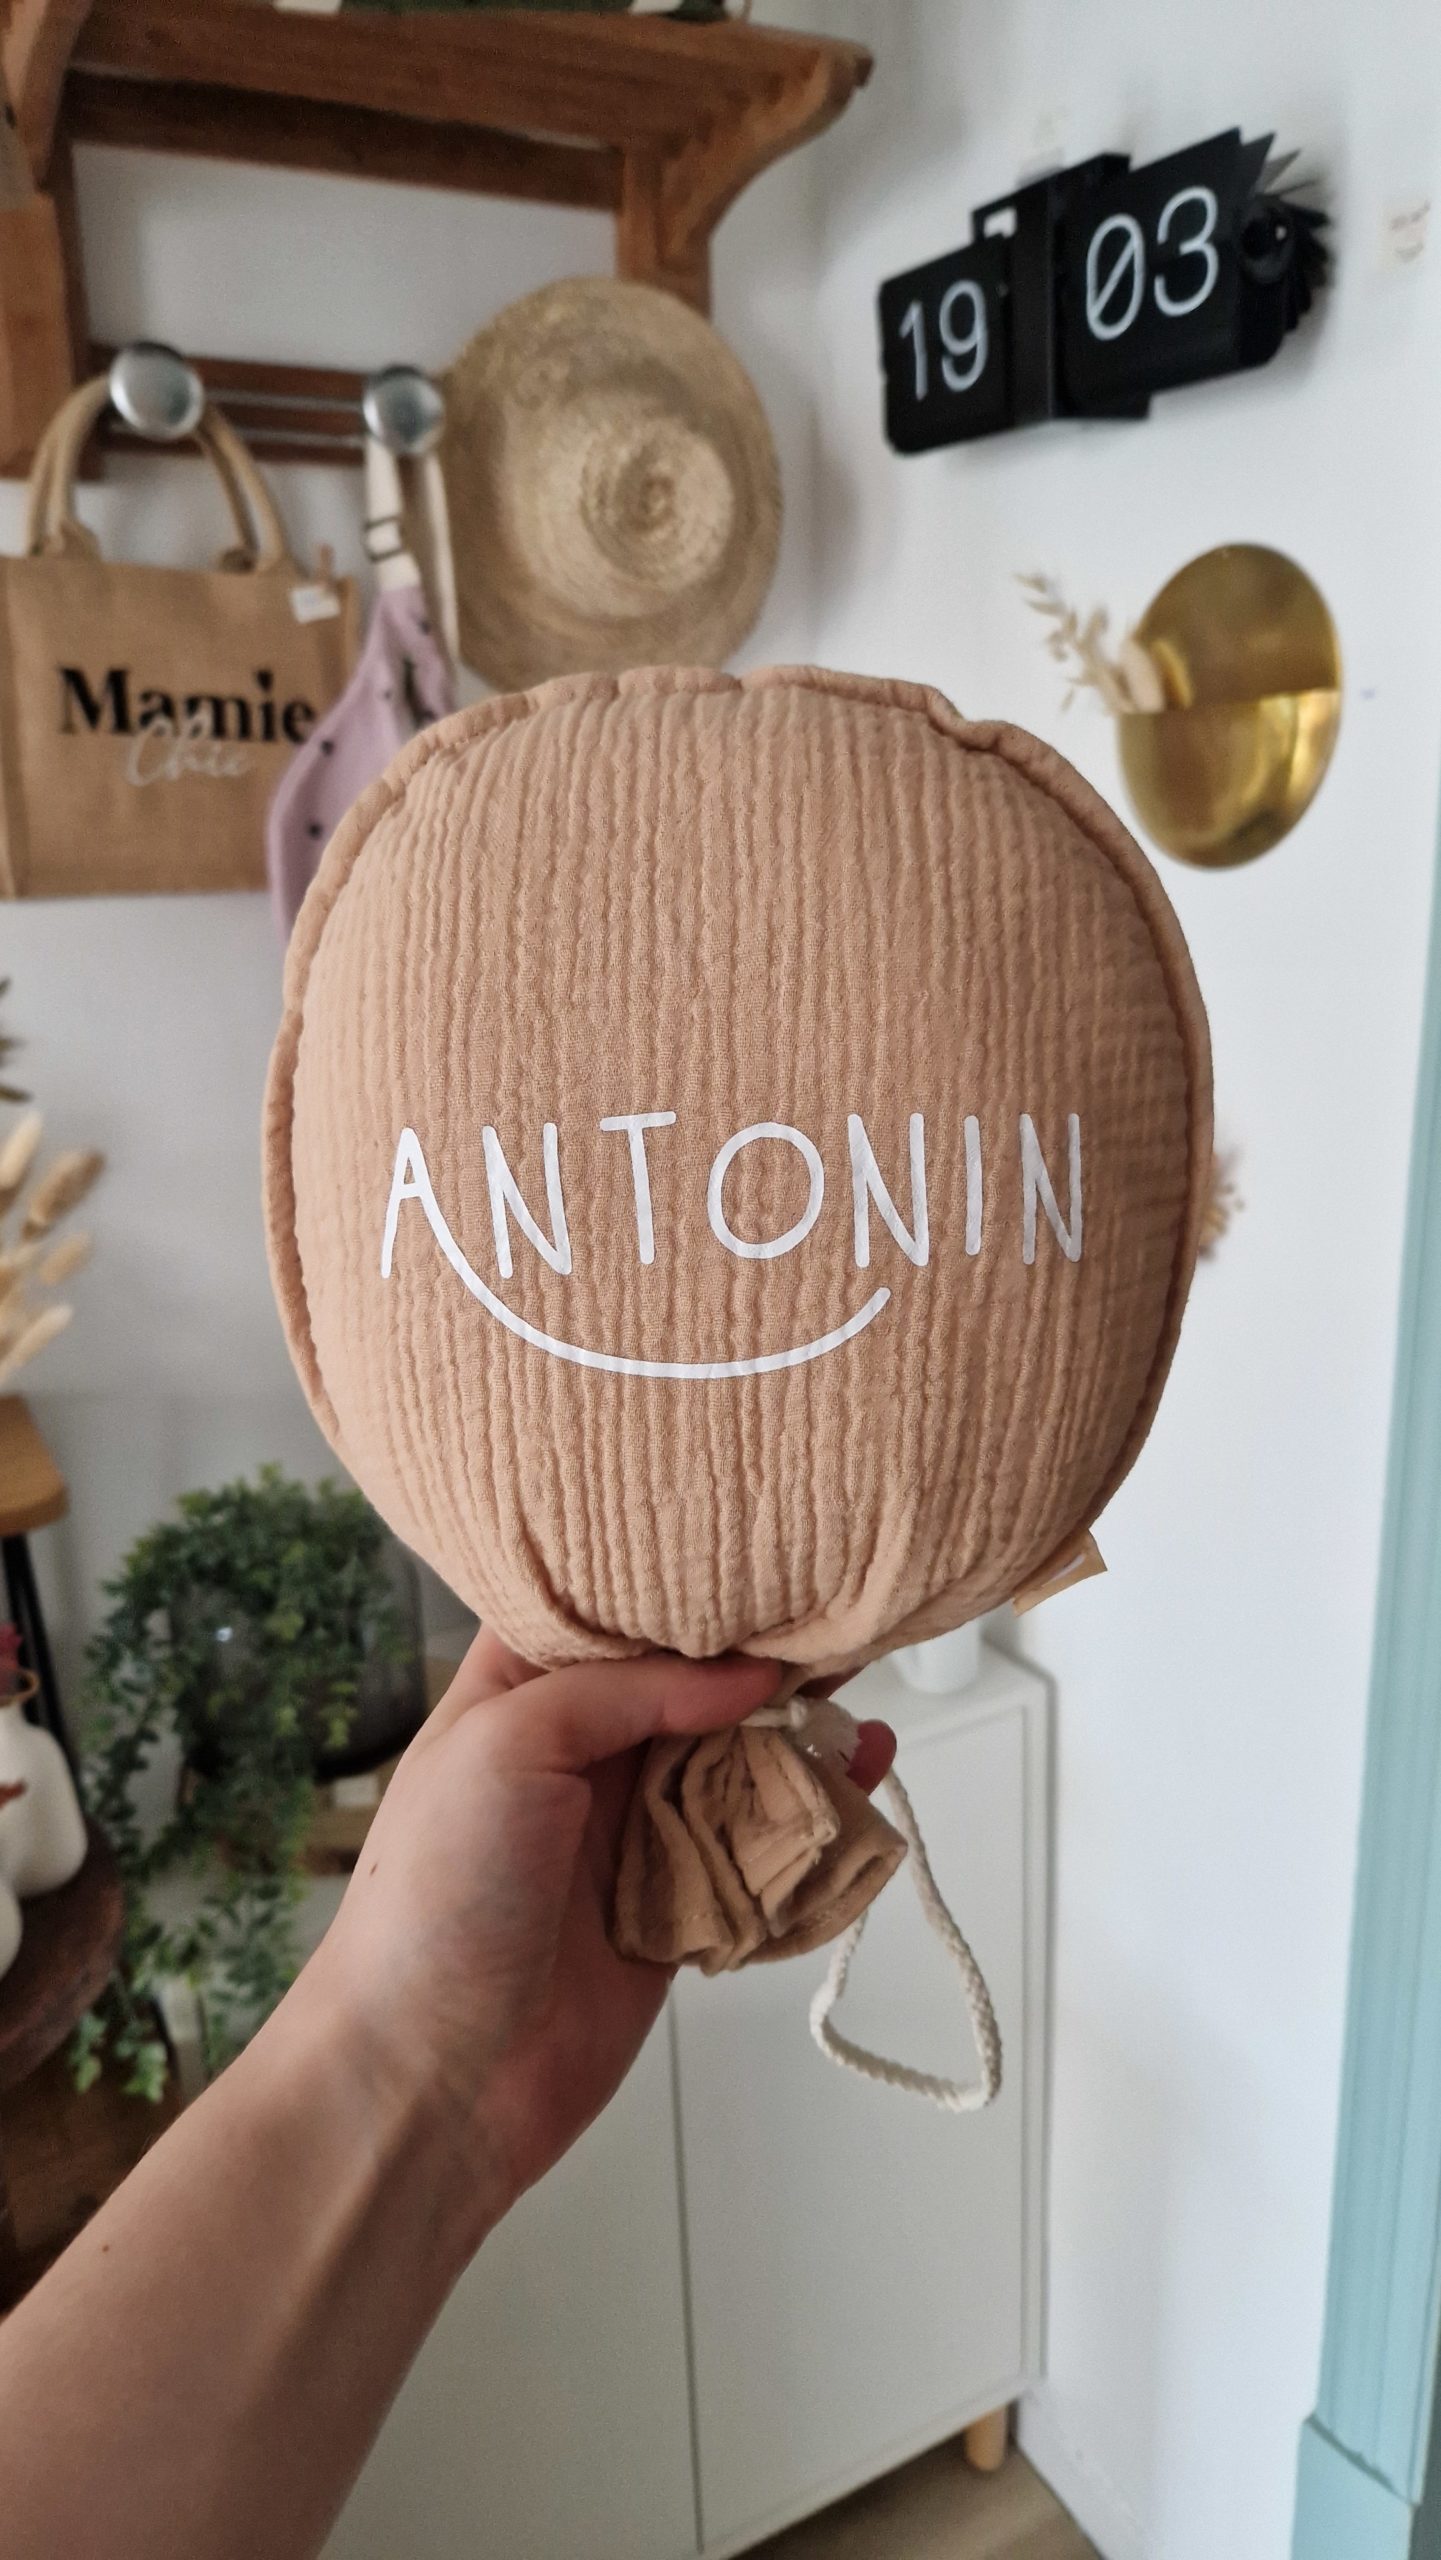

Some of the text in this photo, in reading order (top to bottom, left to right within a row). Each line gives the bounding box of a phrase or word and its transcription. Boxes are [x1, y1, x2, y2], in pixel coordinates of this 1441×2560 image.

[899, 185, 1218, 402] 19 03
[58, 667, 316, 744] Mamie
[127, 707, 254, 788] Chic
[379, 1111, 1084, 1379] ANTONIN
